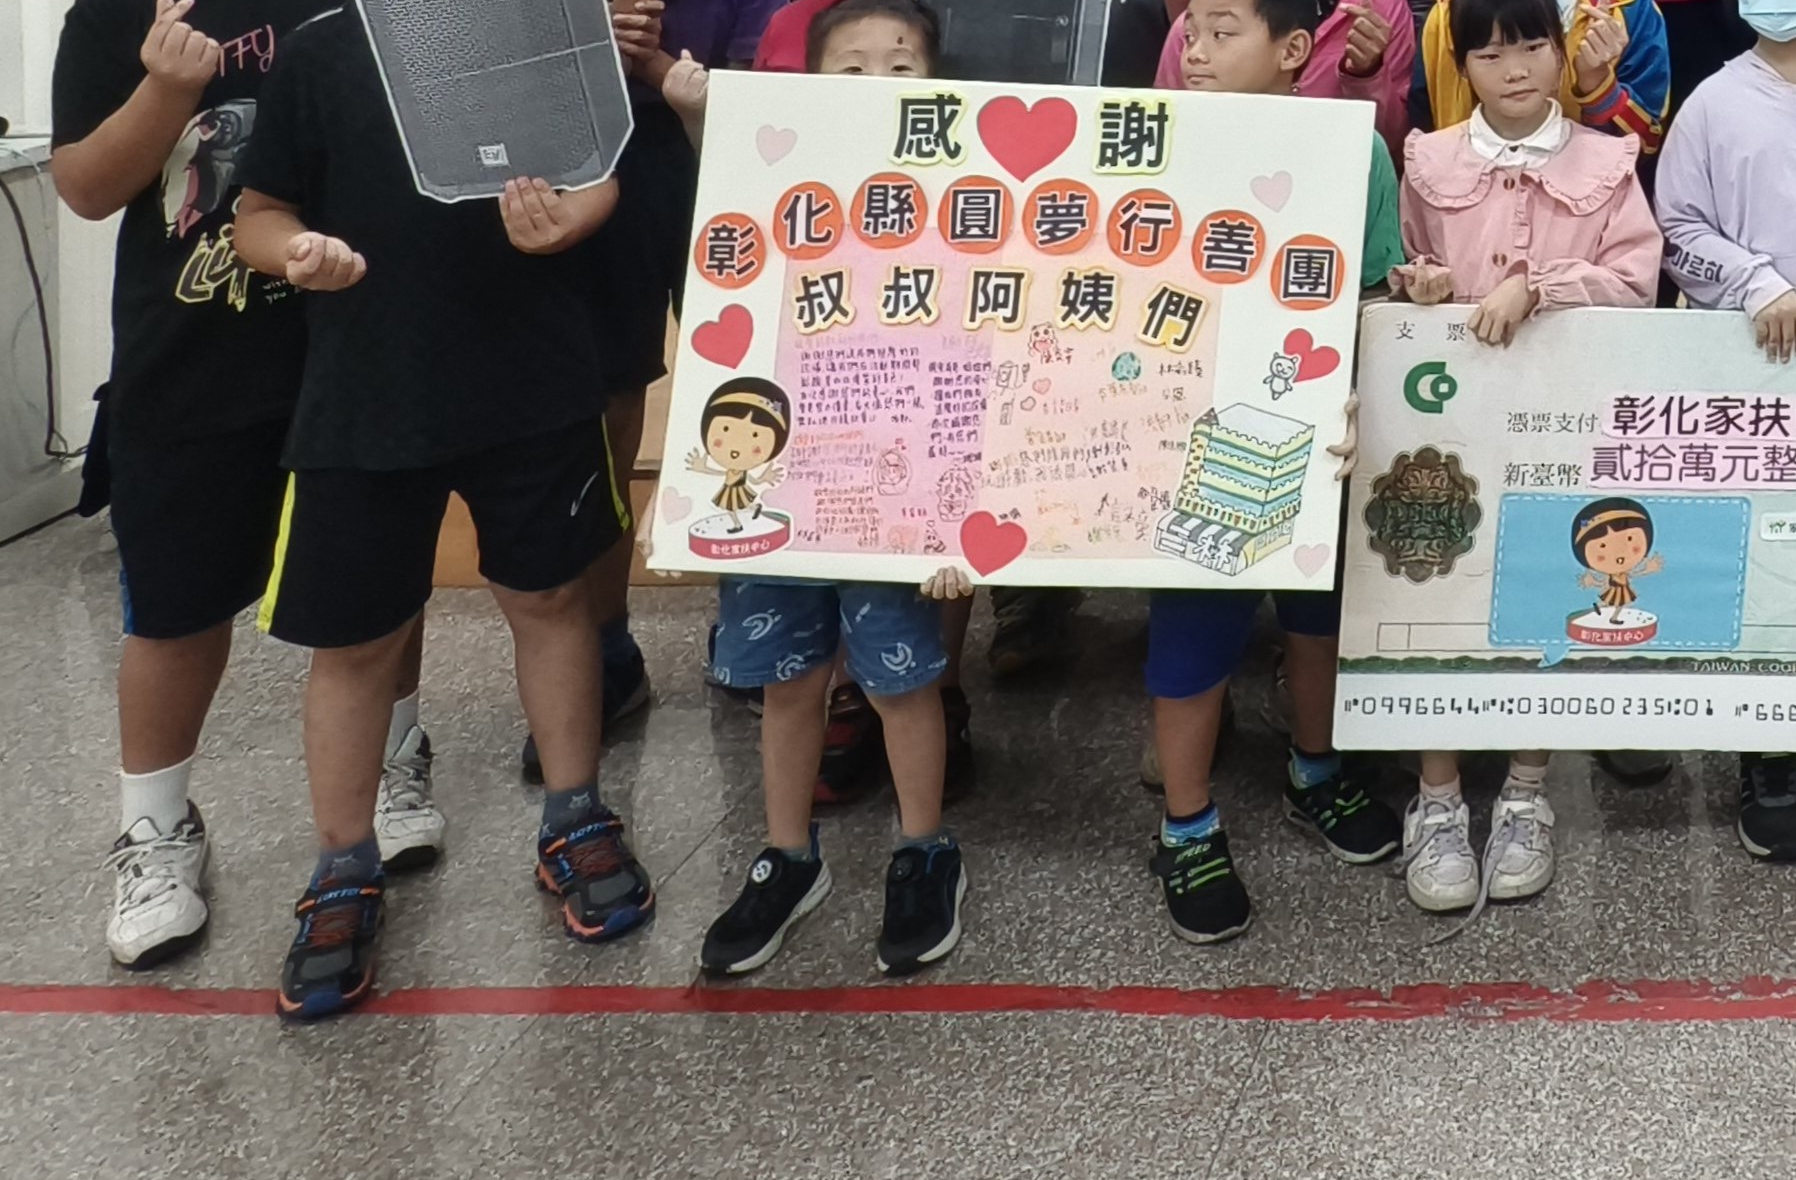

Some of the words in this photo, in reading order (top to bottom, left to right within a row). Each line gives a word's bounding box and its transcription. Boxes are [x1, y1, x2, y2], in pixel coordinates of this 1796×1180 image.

[704, 183, 1338, 303] 彰化縣圓夢行善團
[795, 267, 1210, 348] 叔叔阿姨們
[1502, 461, 1582, 488] 新臺幣
[1690, 661, 1750, 672] TAIWAN
